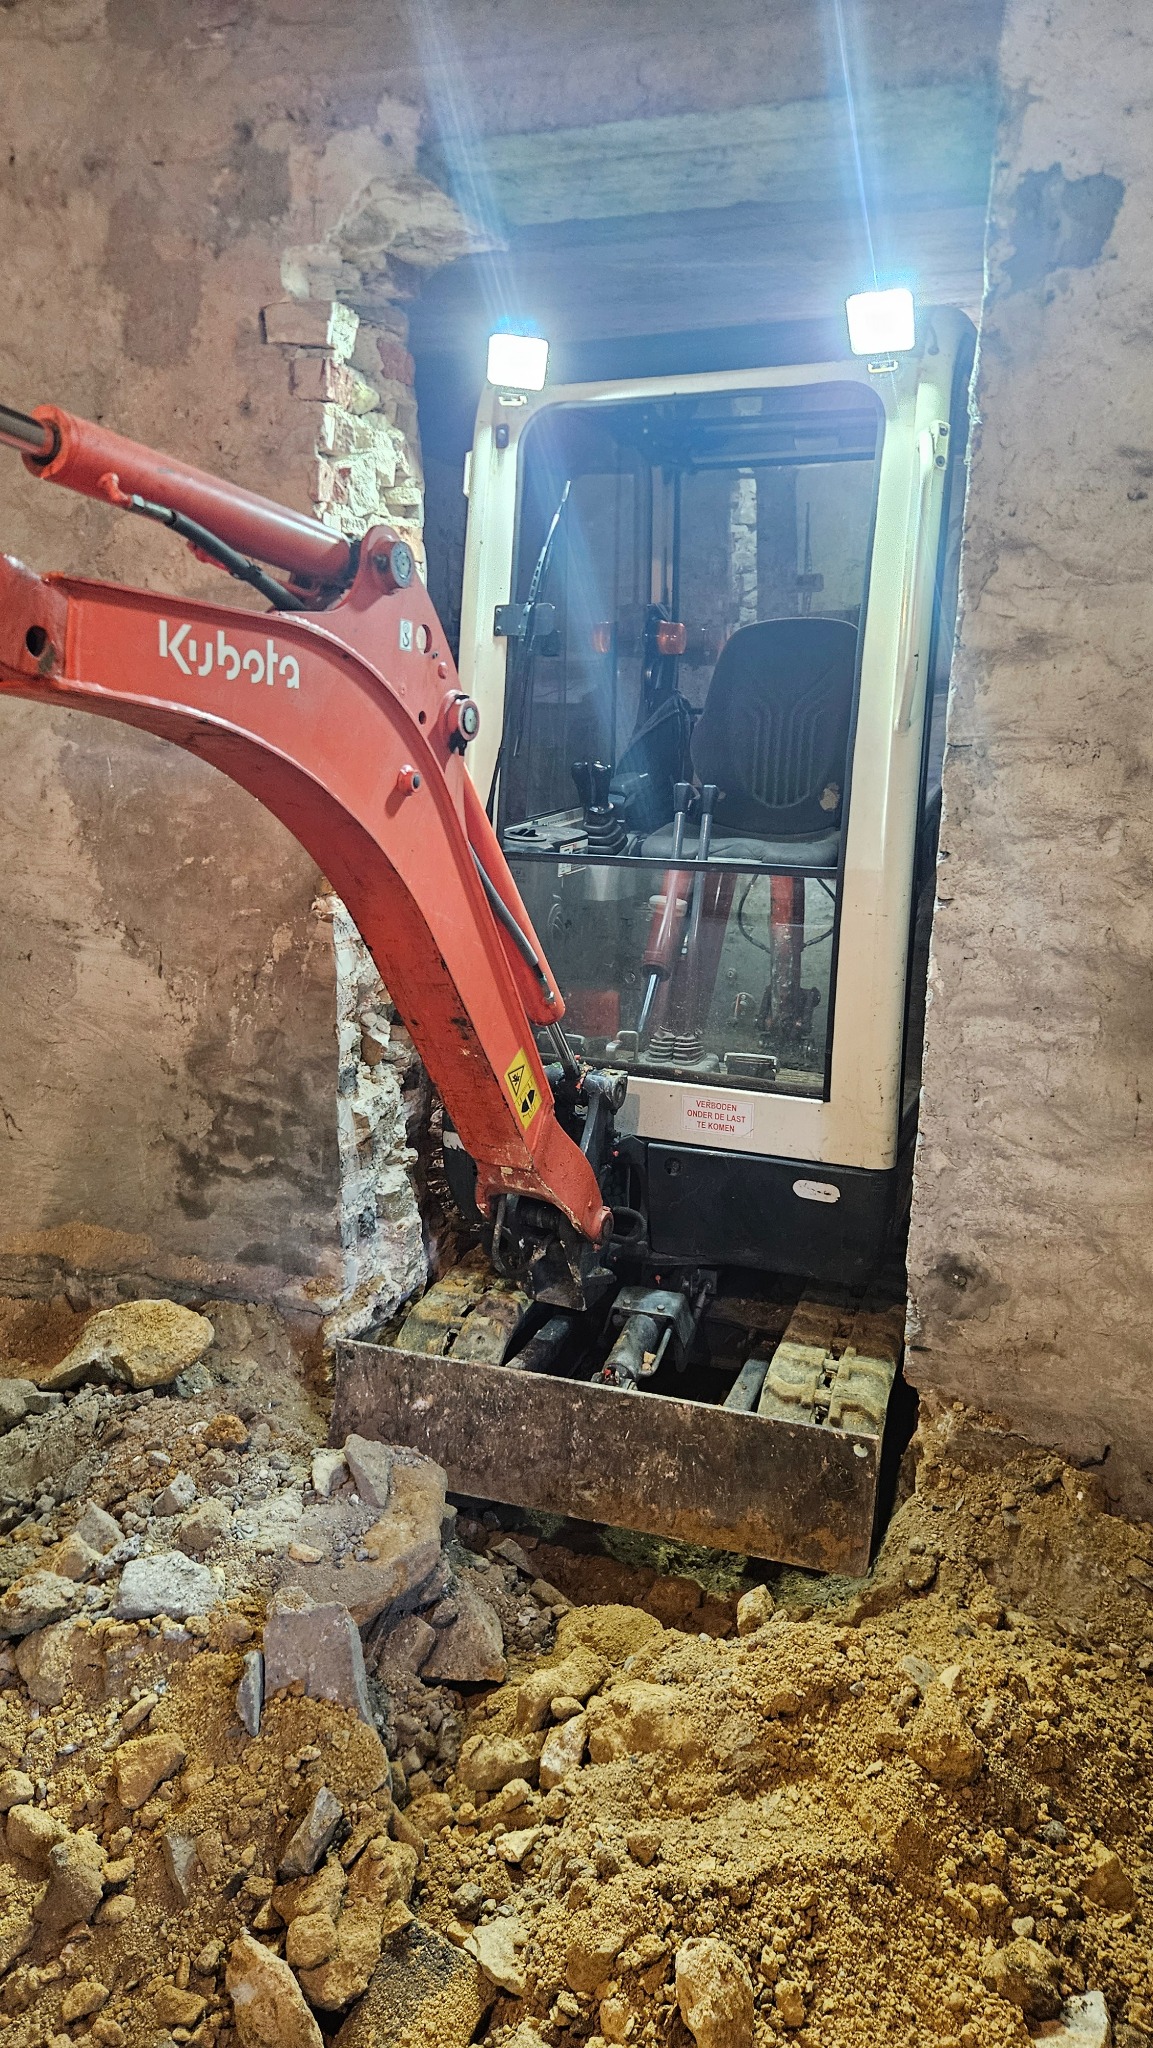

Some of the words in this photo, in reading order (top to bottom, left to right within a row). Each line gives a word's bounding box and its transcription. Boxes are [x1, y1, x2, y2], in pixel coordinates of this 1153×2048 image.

[158, 619, 300, 689] Kubota
[696, 1100, 737, 1111] VERBODEN
[687, 1110, 713, 1119] ONDER
[726, 1114, 746, 1123] LAST
[708, 1122, 735, 1132] KOMEN
